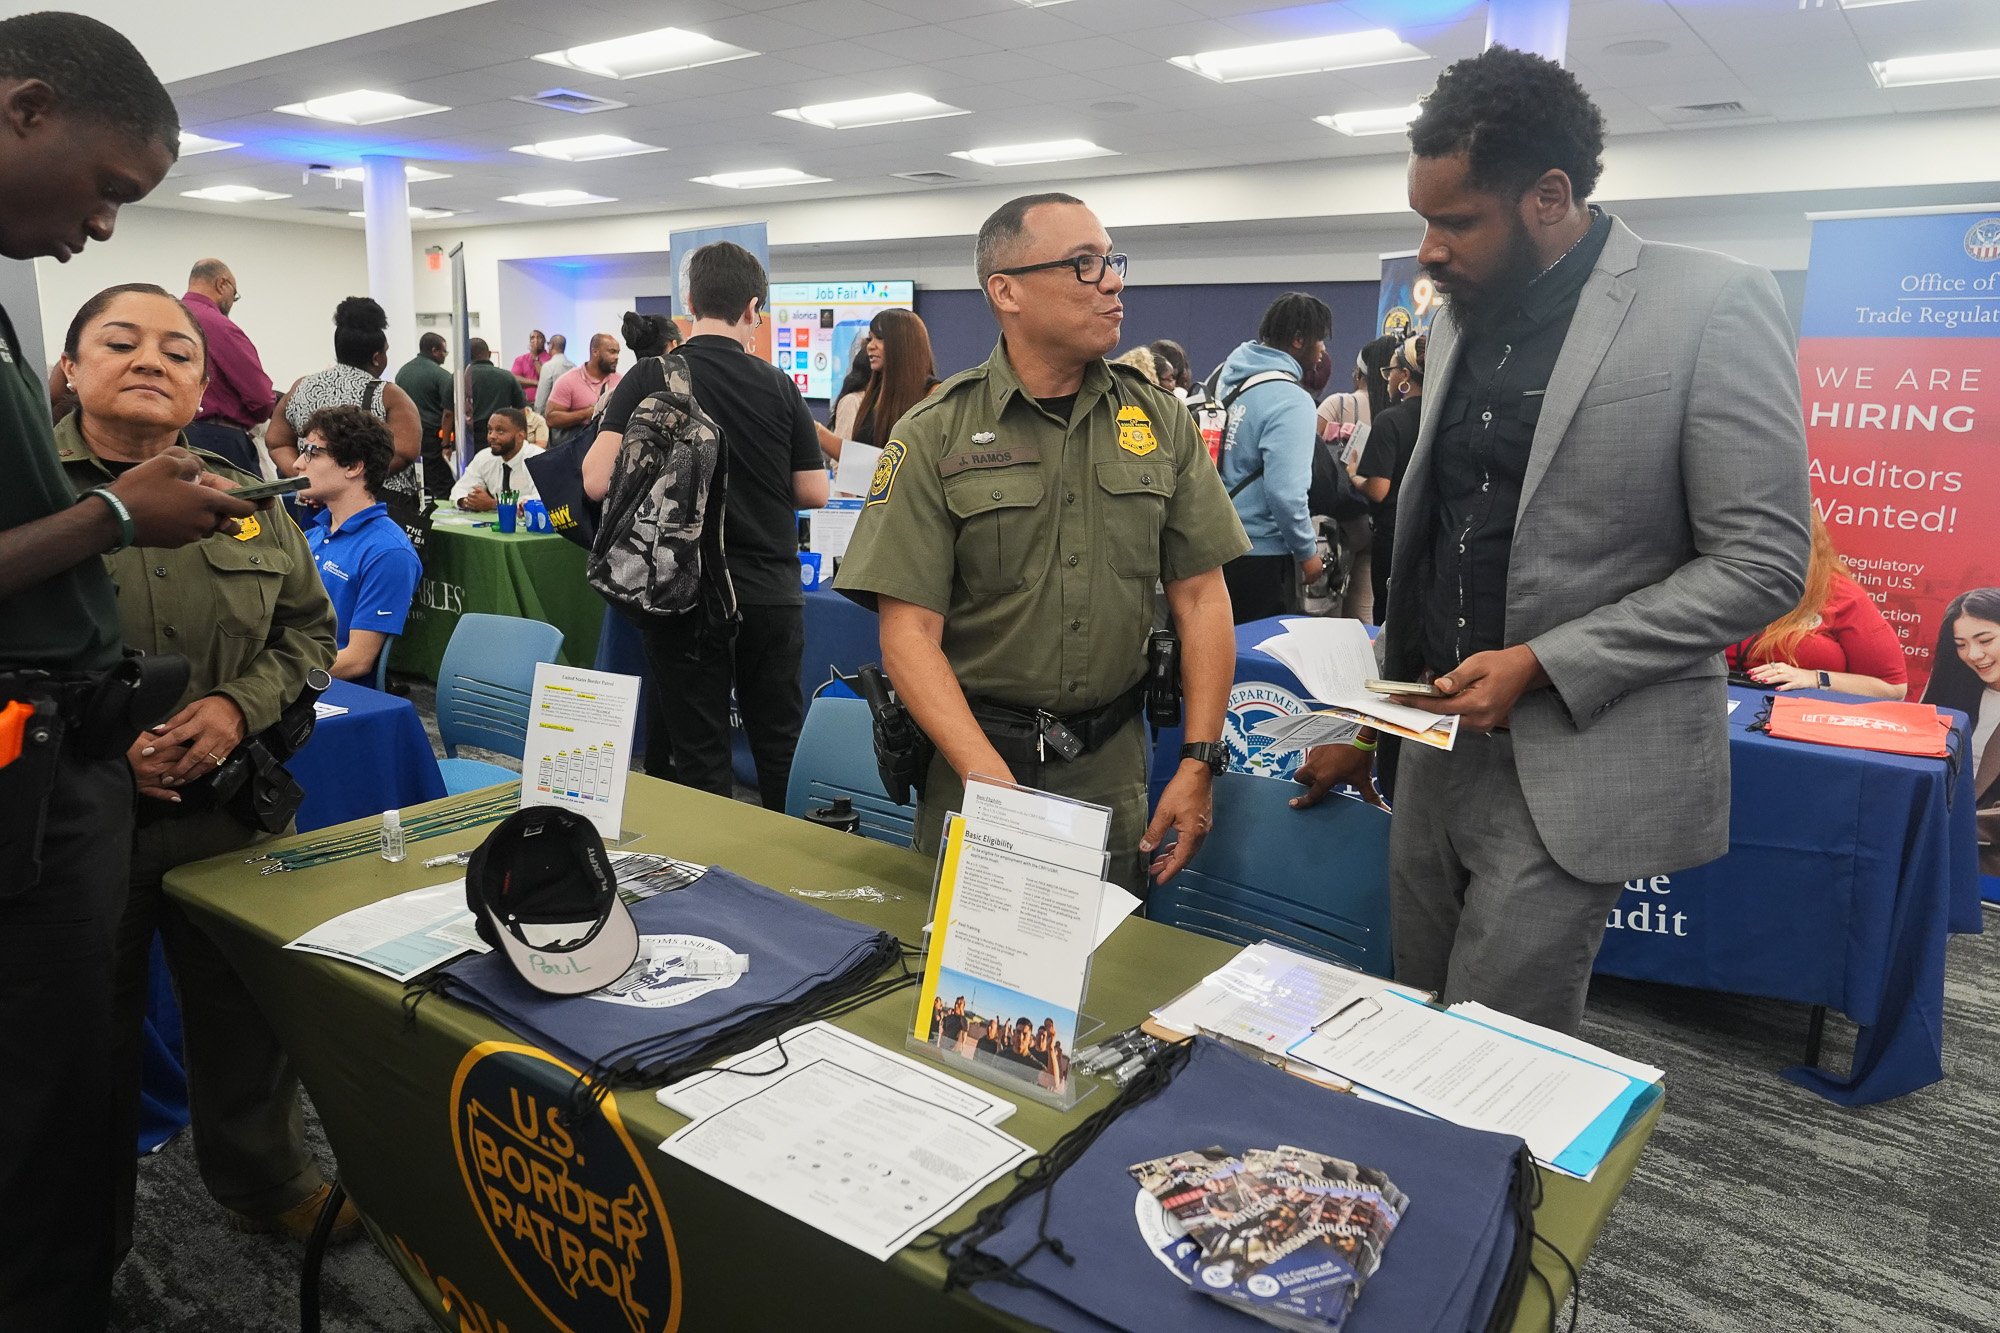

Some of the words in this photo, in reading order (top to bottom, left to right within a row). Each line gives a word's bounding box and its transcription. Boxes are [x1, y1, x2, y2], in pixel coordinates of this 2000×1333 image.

[1901, 273, 1966, 292] Office
[1973, 272, 2000, 291] of
[816, 287, 834, 300] Job
[837, 287, 858, 300] Fair
[1856, 306, 1912, 323] Trade
[1918, 305, 2000, 329] Regulat
[1816, 367, 1875, 389] WE
[1895, 368, 1982, 392] ARE
[1810, 402, 1976, 433] HIRING
[971, 452, 1012, 465] RAMOS
[1808, 458, 1963, 492] Auditors
[549, 507, 572, 527] AVY
[405, 525, 423, 537] THE
[1838, 554, 1925, 576] Regulatory
[1851, 572, 1882, 587] thin
[1887, 576, 1916, 590] U.S.
[1867, 591, 1888, 603] nd
[1879, 609, 1921, 623] ction
[1897, 626, 1910, 639] is
[1900, 644, 1930, 658] tors
[1227, 689, 1303, 714] DEPARTMEN
[965, 830, 981, 839] Basic
[982, 834, 1013, 850] Eligibility
[999, 854, 1022, 864] employment
[1624, 874, 1671, 895] de
[966, 924, 980, 932] Training
[1605, 902, 1688, 937] udit
[640, 937, 680, 945] TOMS
[510, 1087, 585, 1167] U.S.
[475, 1129, 642, 1261] BORDER
[487, 1185, 650, 1318] PATROL
